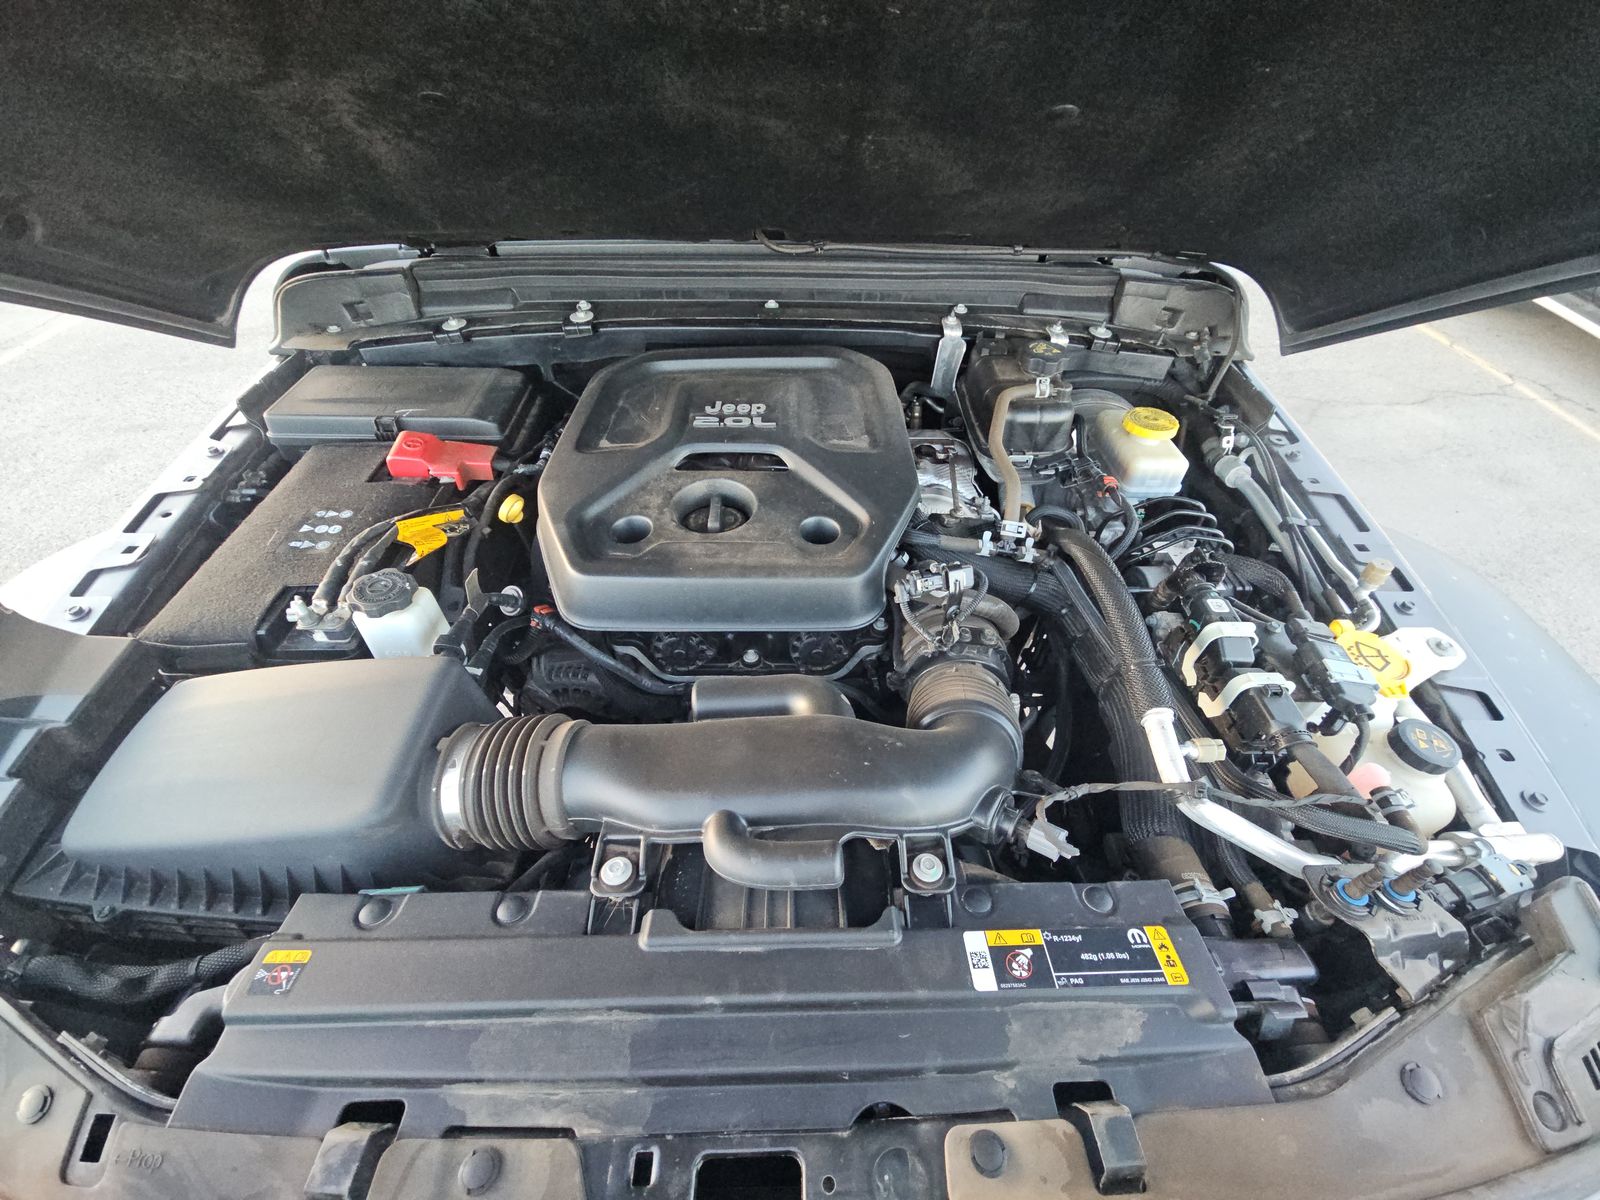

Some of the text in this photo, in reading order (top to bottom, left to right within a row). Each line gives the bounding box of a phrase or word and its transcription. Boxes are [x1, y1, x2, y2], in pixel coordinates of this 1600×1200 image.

[704, 400, 767, 416] Jeep
[692, 416, 777, 428] 2.0L
[1070, 977, 1084, 985] PAG
